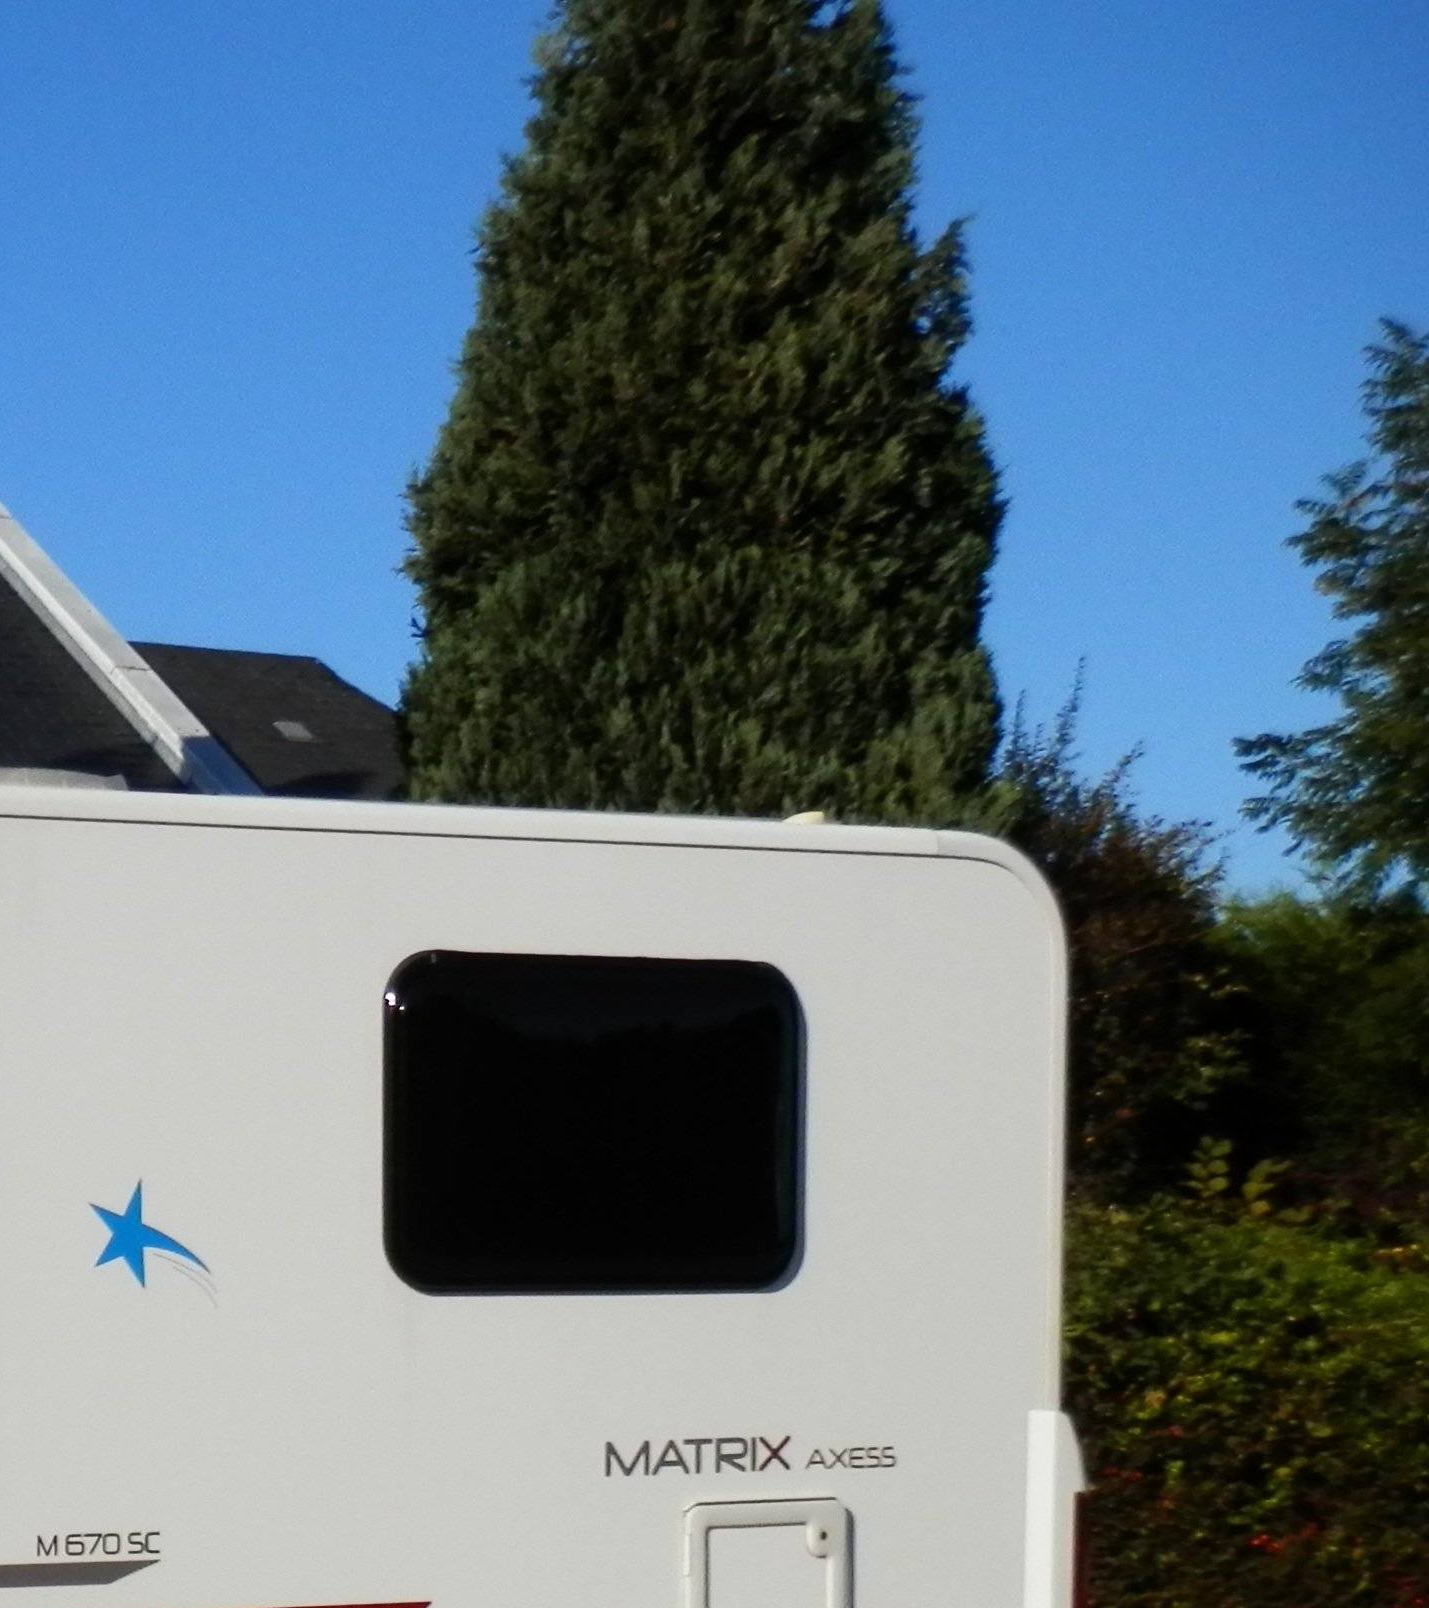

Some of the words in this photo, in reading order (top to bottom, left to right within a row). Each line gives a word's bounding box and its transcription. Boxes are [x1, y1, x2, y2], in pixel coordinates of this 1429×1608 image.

[604, 1435, 791, 1477] MATRIX
[805, 1446, 897, 1469] AXESS
[36, 1535, 58, 1556] M
[65, 1533, 121, 1556] 670
[127, 1531, 161, 1554] SC
